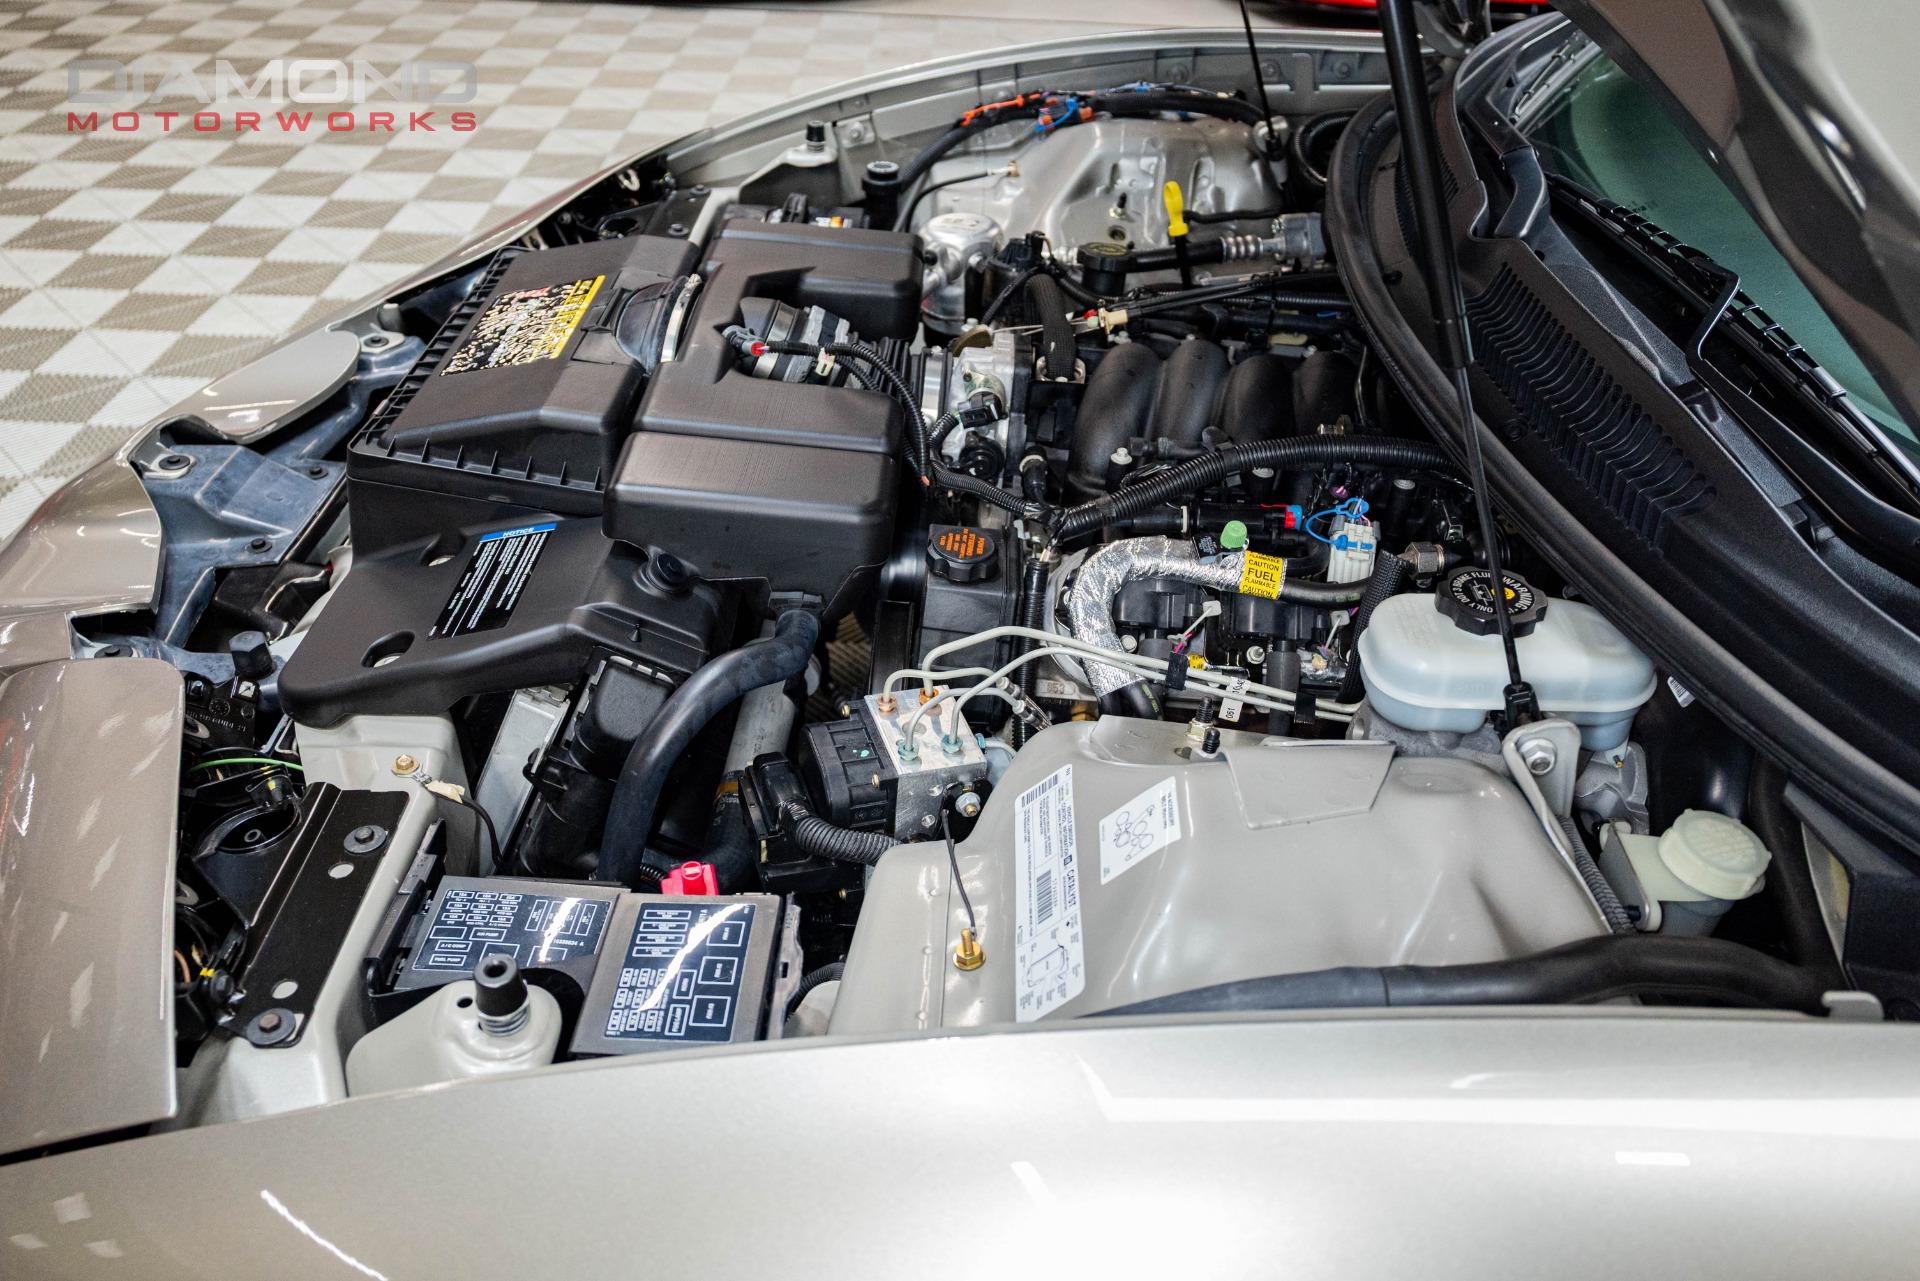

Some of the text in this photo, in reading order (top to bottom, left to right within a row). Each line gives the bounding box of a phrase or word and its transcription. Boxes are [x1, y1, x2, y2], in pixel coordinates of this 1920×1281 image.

[503, 527, 534, 538] NOTICE
[976, 537, 985, 554] POWER
[1248, 560, 1279, 571] CAUTION
[1247, 568, 1276, 582] FUEL
[1244, 577, 1276, 589] FLAMMABLE
[1242, 584, 1274, 597] CAUTION
[1454, 592, 1470, 603] DOT
[1469, 602, 1493, 613] ONLY
[1066, 869, 1077, 907] CATALYST
